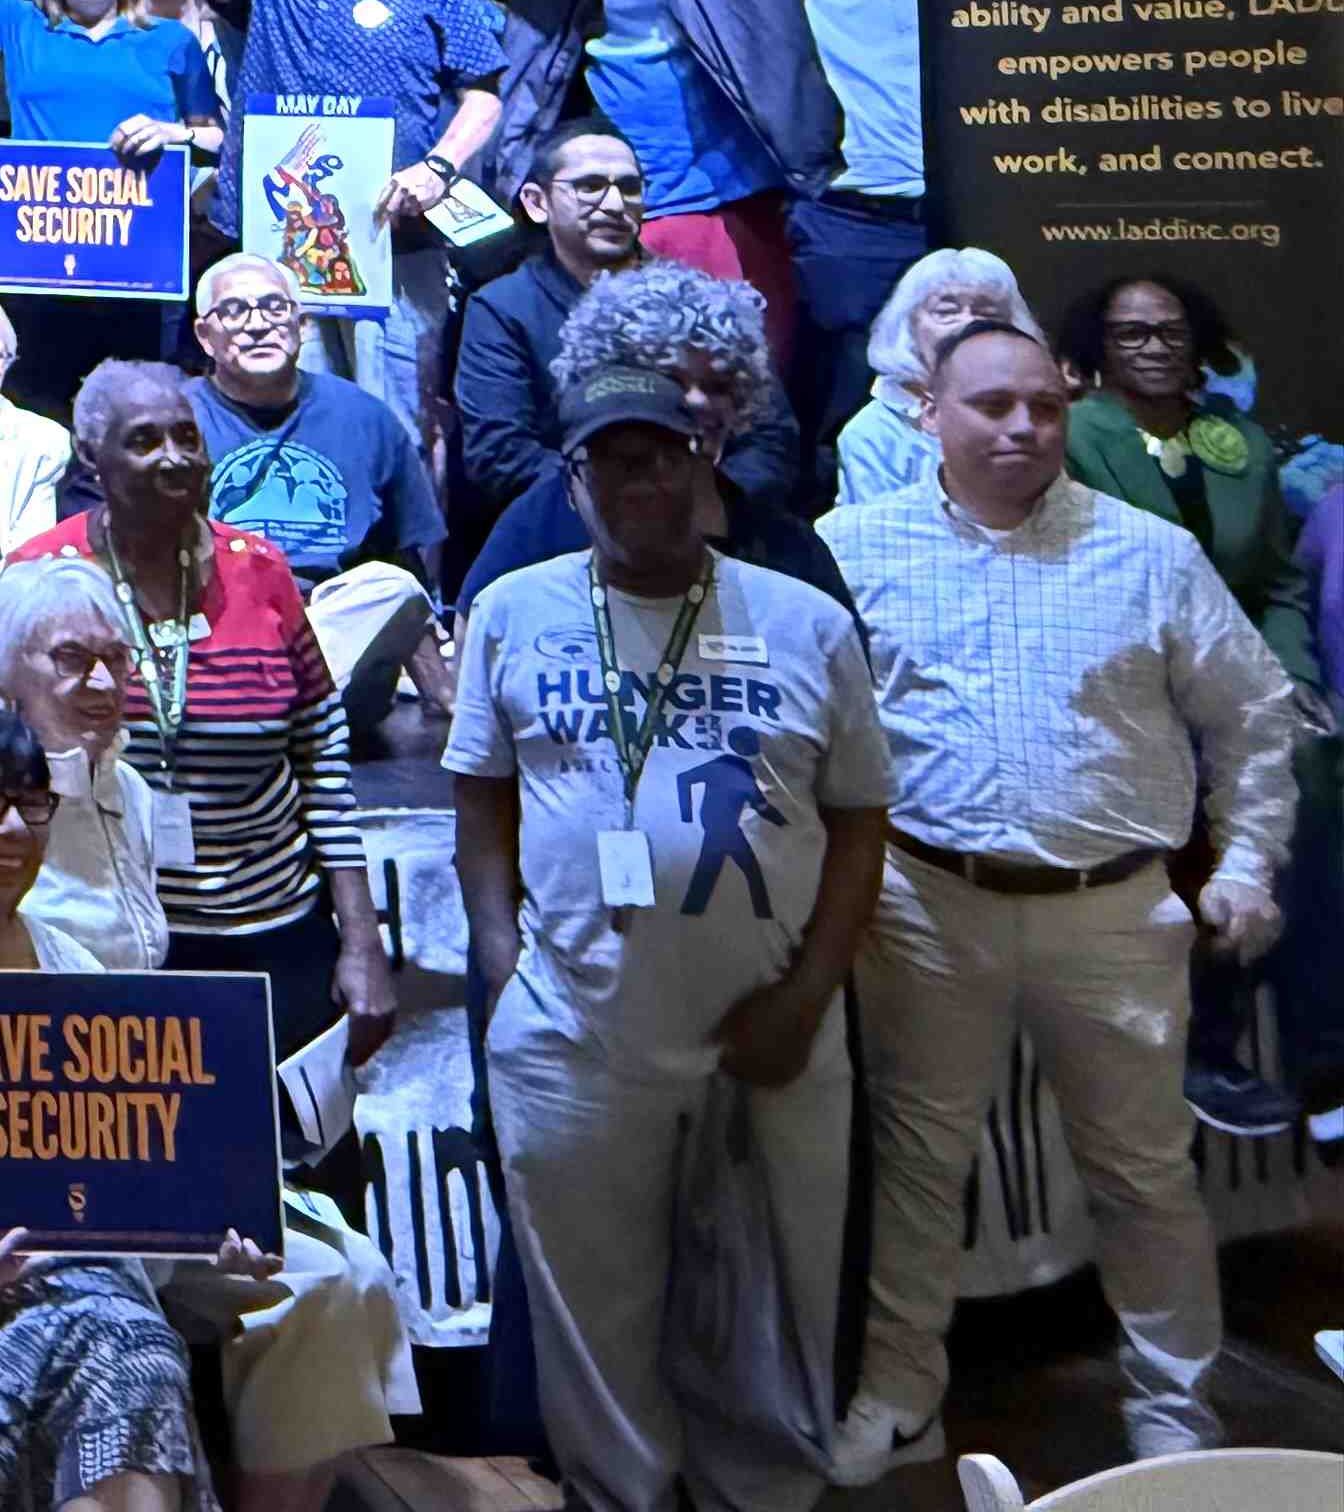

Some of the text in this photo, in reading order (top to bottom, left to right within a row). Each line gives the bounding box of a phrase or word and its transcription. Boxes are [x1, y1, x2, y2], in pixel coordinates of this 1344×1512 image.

[951, 0, 1052, 33] ability
[997, 39, 1309, 80] empowers people
[275, 93, 363, 116] MAY DAY
[959, 97, 1031, 126] with
[1040, 94, 1223, 124] disabilities
[1232, 95, 1272, 119] to
[992, 144, 1324, 176] work, and connect.
[65, 166, 155, 207] SOCIAL
[15, 204, 133, 247] SECURITY
[1041, 217, 1281, 247] www.laddinc.org
[62, 1013, 217, 1086] SOCIAL
